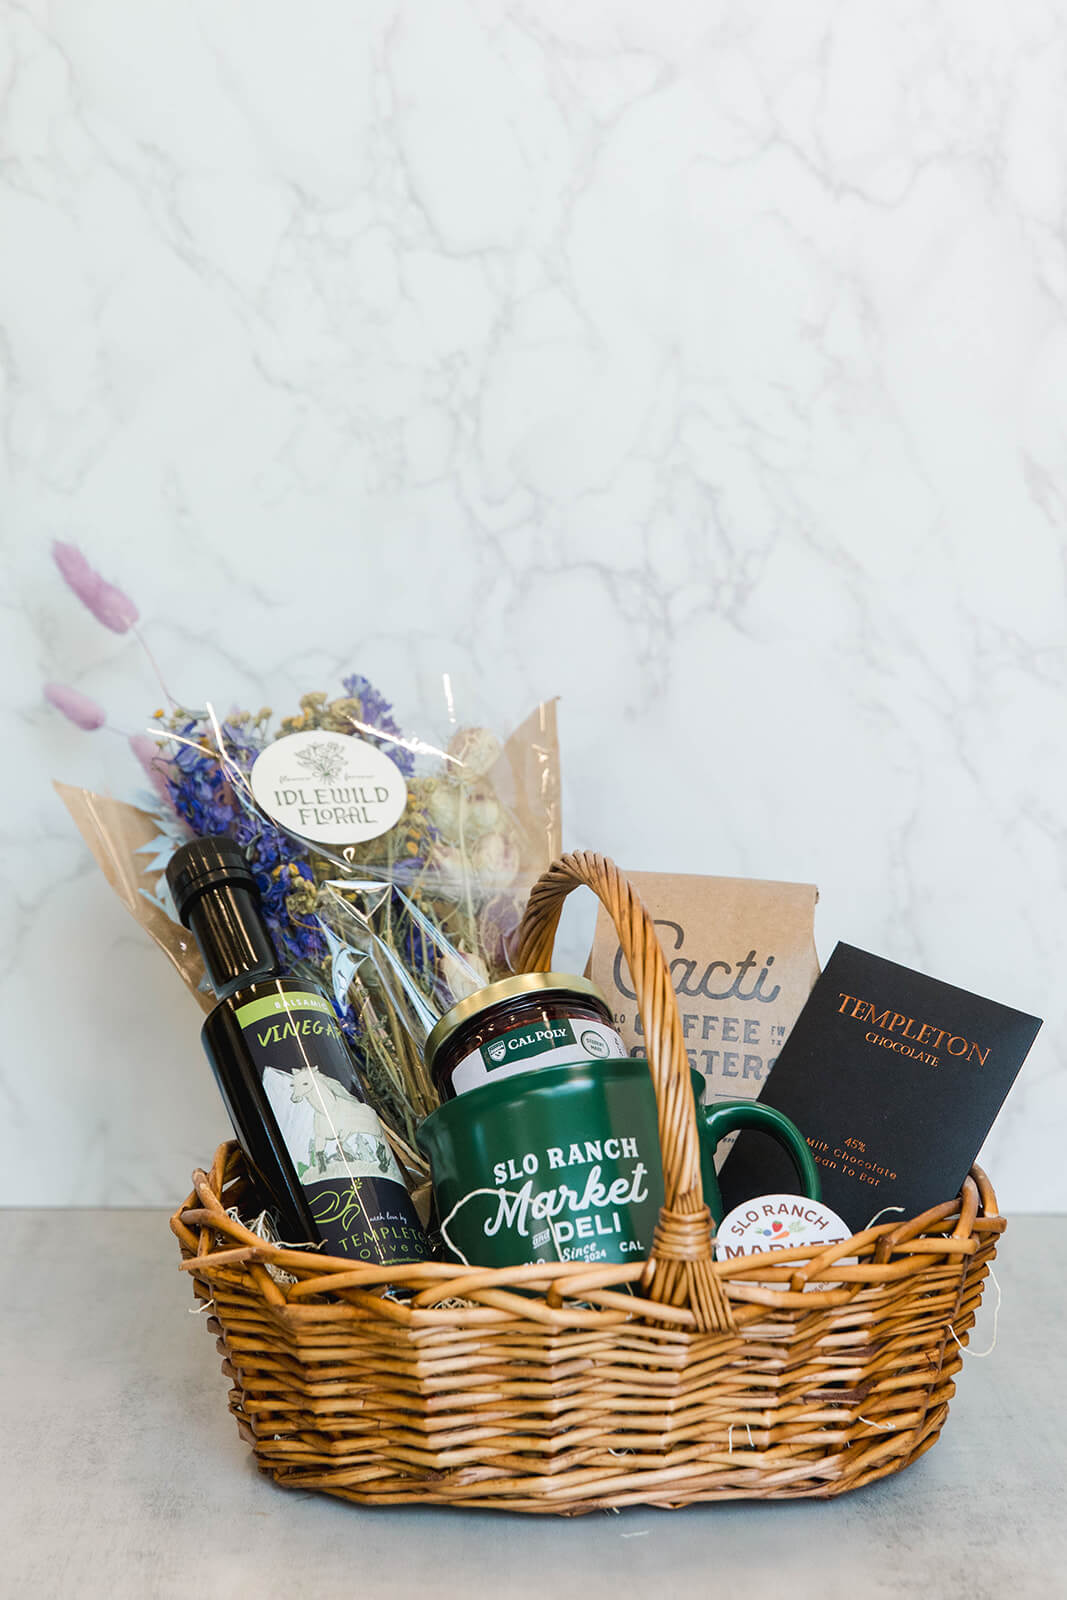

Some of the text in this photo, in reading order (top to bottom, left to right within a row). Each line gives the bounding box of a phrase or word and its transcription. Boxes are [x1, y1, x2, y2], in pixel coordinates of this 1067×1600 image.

[274, 787, 389, 806] IDLEWILD
[298, 806, 379, 825] FLORAL
[613, 919, 781, 1003] Cacti
[507, 1028, 568, 1050] CAL POLY
[634, 1013, 761, 1045] FFEE
[838, 993, 991, 1067] TEMPLETON
[864, 1030, 940, 1068] CHOCOLATE
[494, 1137, 640, 1185] SLO RANCH
[806, 1137, 897, 1180] Milk Chocolate
[844, 1137, 866, 1153] 45%
[812, 1151, 881, 1187] ean To Bar
[484, 1162, 648, 1236] Market
[554, 1212, 621, 1243] DELI
[730, 1203, 829, 1237] SLO RANCH
[561, 1241, 597, 1262] Since
[583, 1249, 607, 1263] 2024
[619, 1240, 645, 1252] CAL
